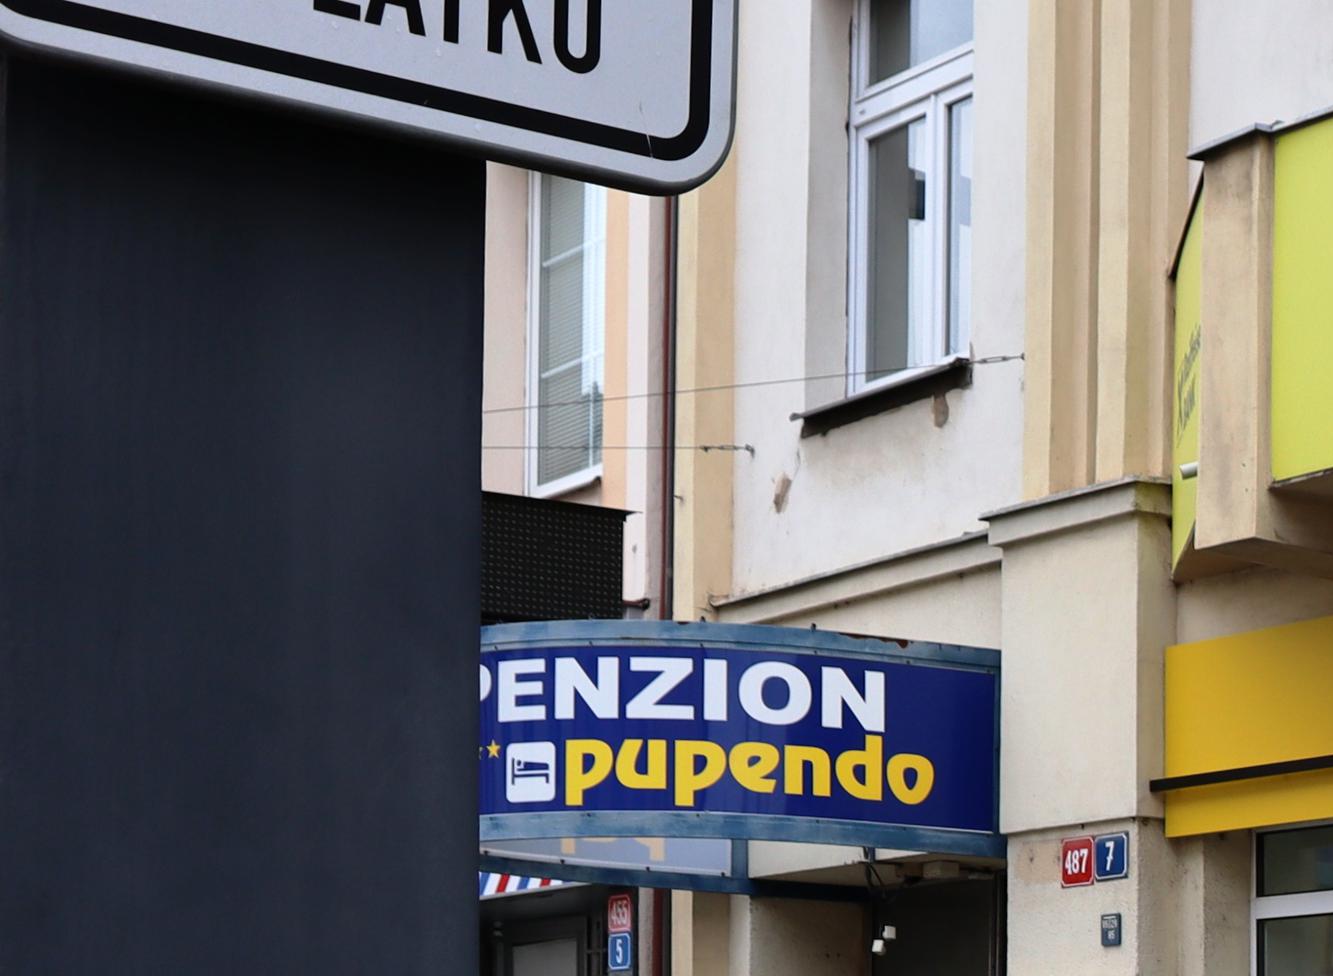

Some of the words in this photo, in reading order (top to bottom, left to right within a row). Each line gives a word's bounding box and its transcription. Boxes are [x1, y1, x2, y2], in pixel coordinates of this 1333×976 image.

[480, 657, 886, 733] ENZION
[565, 736, 935, 807] pupendo
[1064, 847, 1089, 876] 487
[1105, 841, 1115, 871] 7
[615, 938, 624, 964] 5
